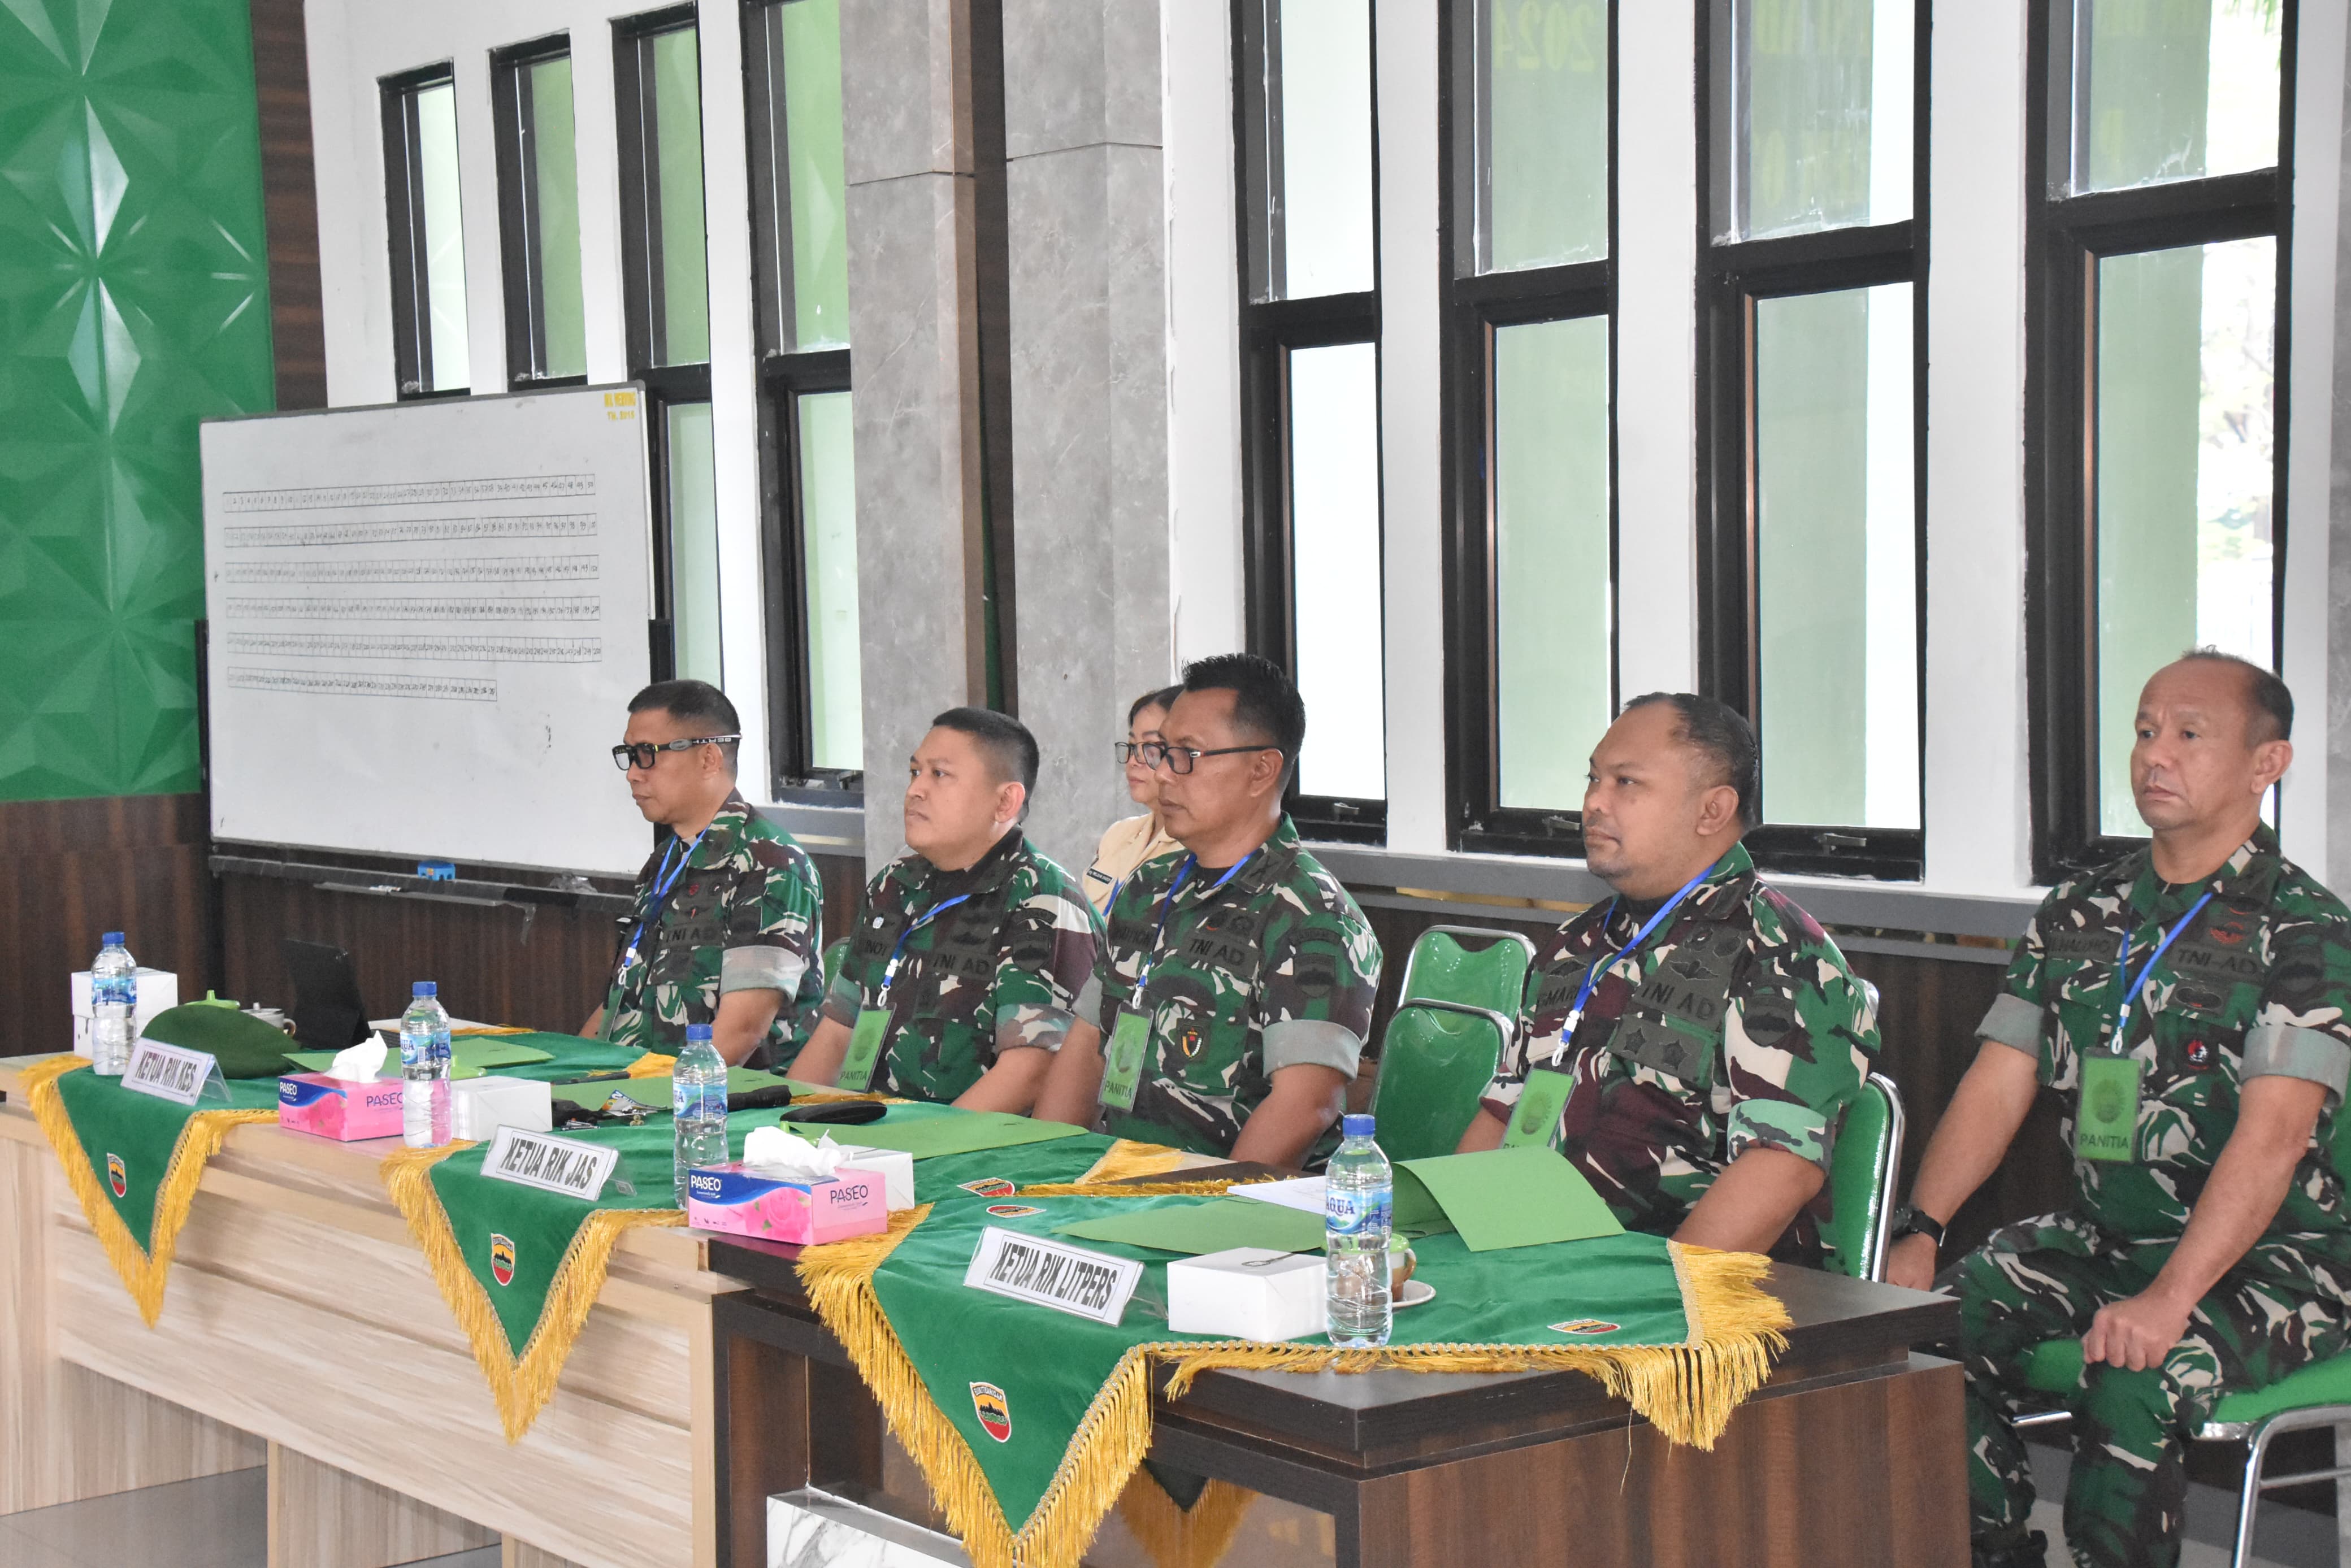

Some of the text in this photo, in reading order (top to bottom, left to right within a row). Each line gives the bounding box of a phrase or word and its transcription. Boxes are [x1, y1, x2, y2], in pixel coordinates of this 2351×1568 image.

[1188, 938, 1245, 966] TNI AD
[962, 957, 990, 975] AD
[1676, 992, 1715, 1020] AD
[135, 1050, 197, 1092] KETUA RIK KES
[840, 1071, 867, 1081] PANITIA
[280, 1081, 297, 1096] PASEO
[1104, 1080, 1132, 1099] PANITIA
[2080, 1132, 2129, 1149] PANITIA
[500, 1137, 597, 1189] KETUA RIK JAS
[691, 1175, 721, 1191] PASEO
[830, 1184, 868, 1204] PASEO
[990, 1241, 1117, 1310] KETUA RIK LITPERS
